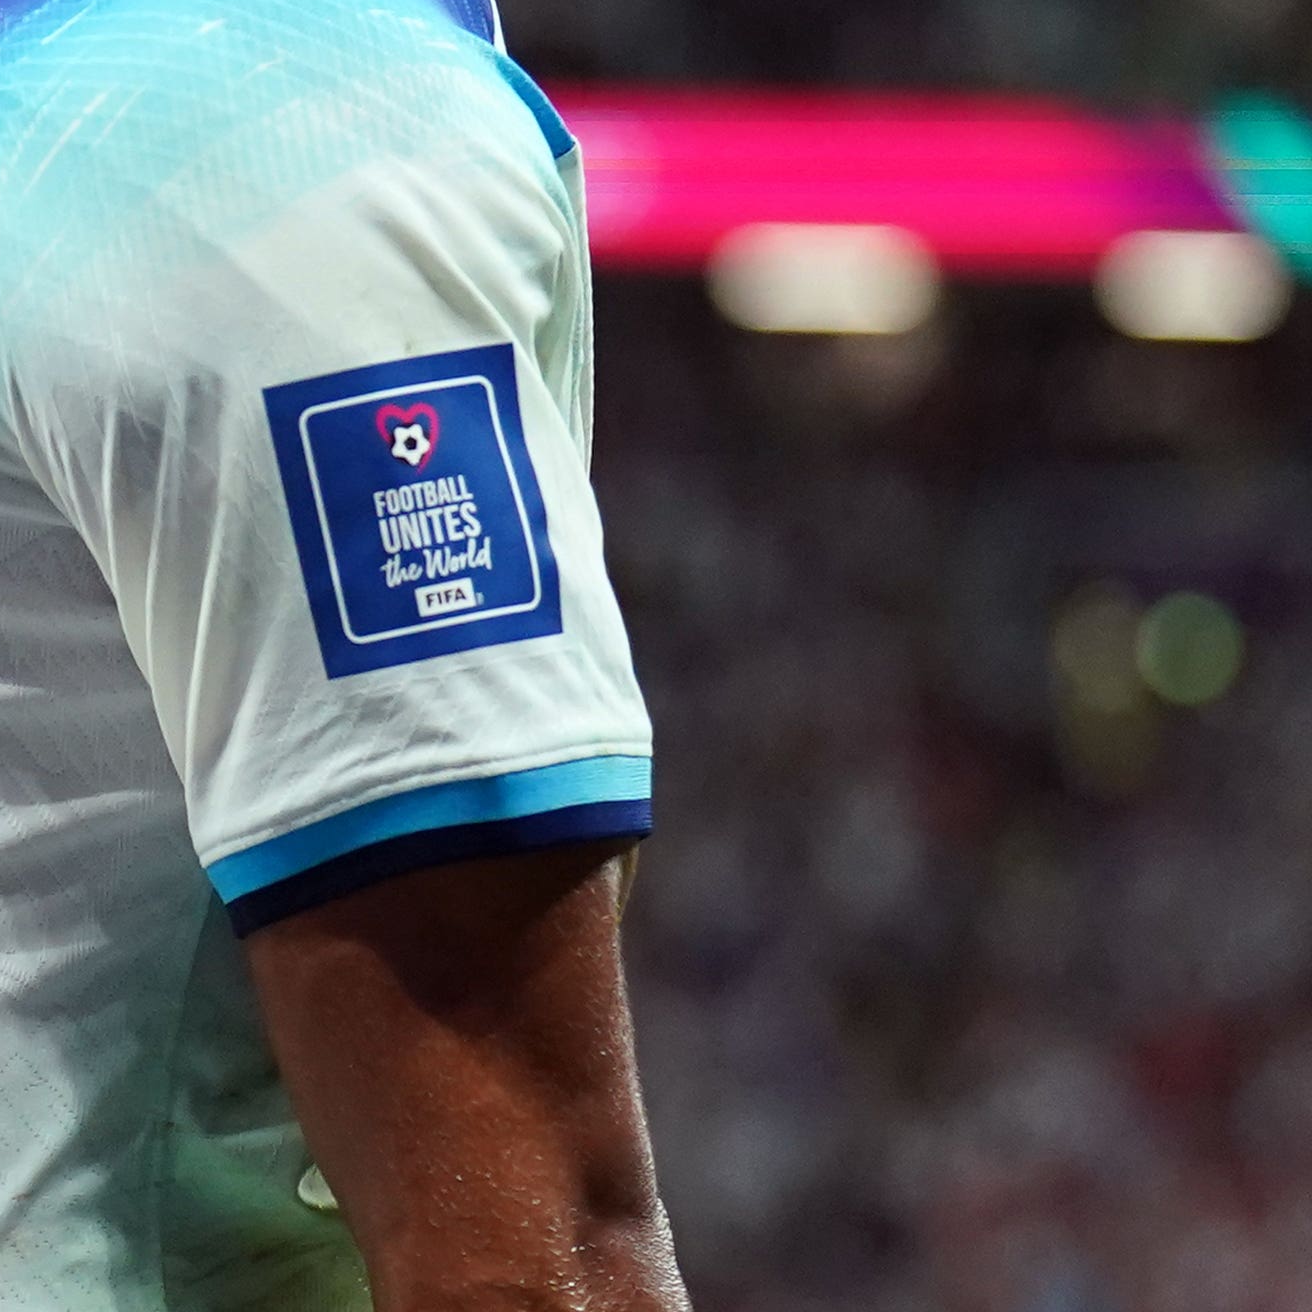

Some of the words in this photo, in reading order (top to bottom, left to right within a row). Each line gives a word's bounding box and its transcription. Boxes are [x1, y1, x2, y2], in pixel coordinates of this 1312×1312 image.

[373, 474, 474, 517] FOOTBALL
[379, 501, 481, 554] UNITES
[380, 553, 423, 588] the
[423, 536, 492, 579] World
[425, 587, 467, 608] FIFA
